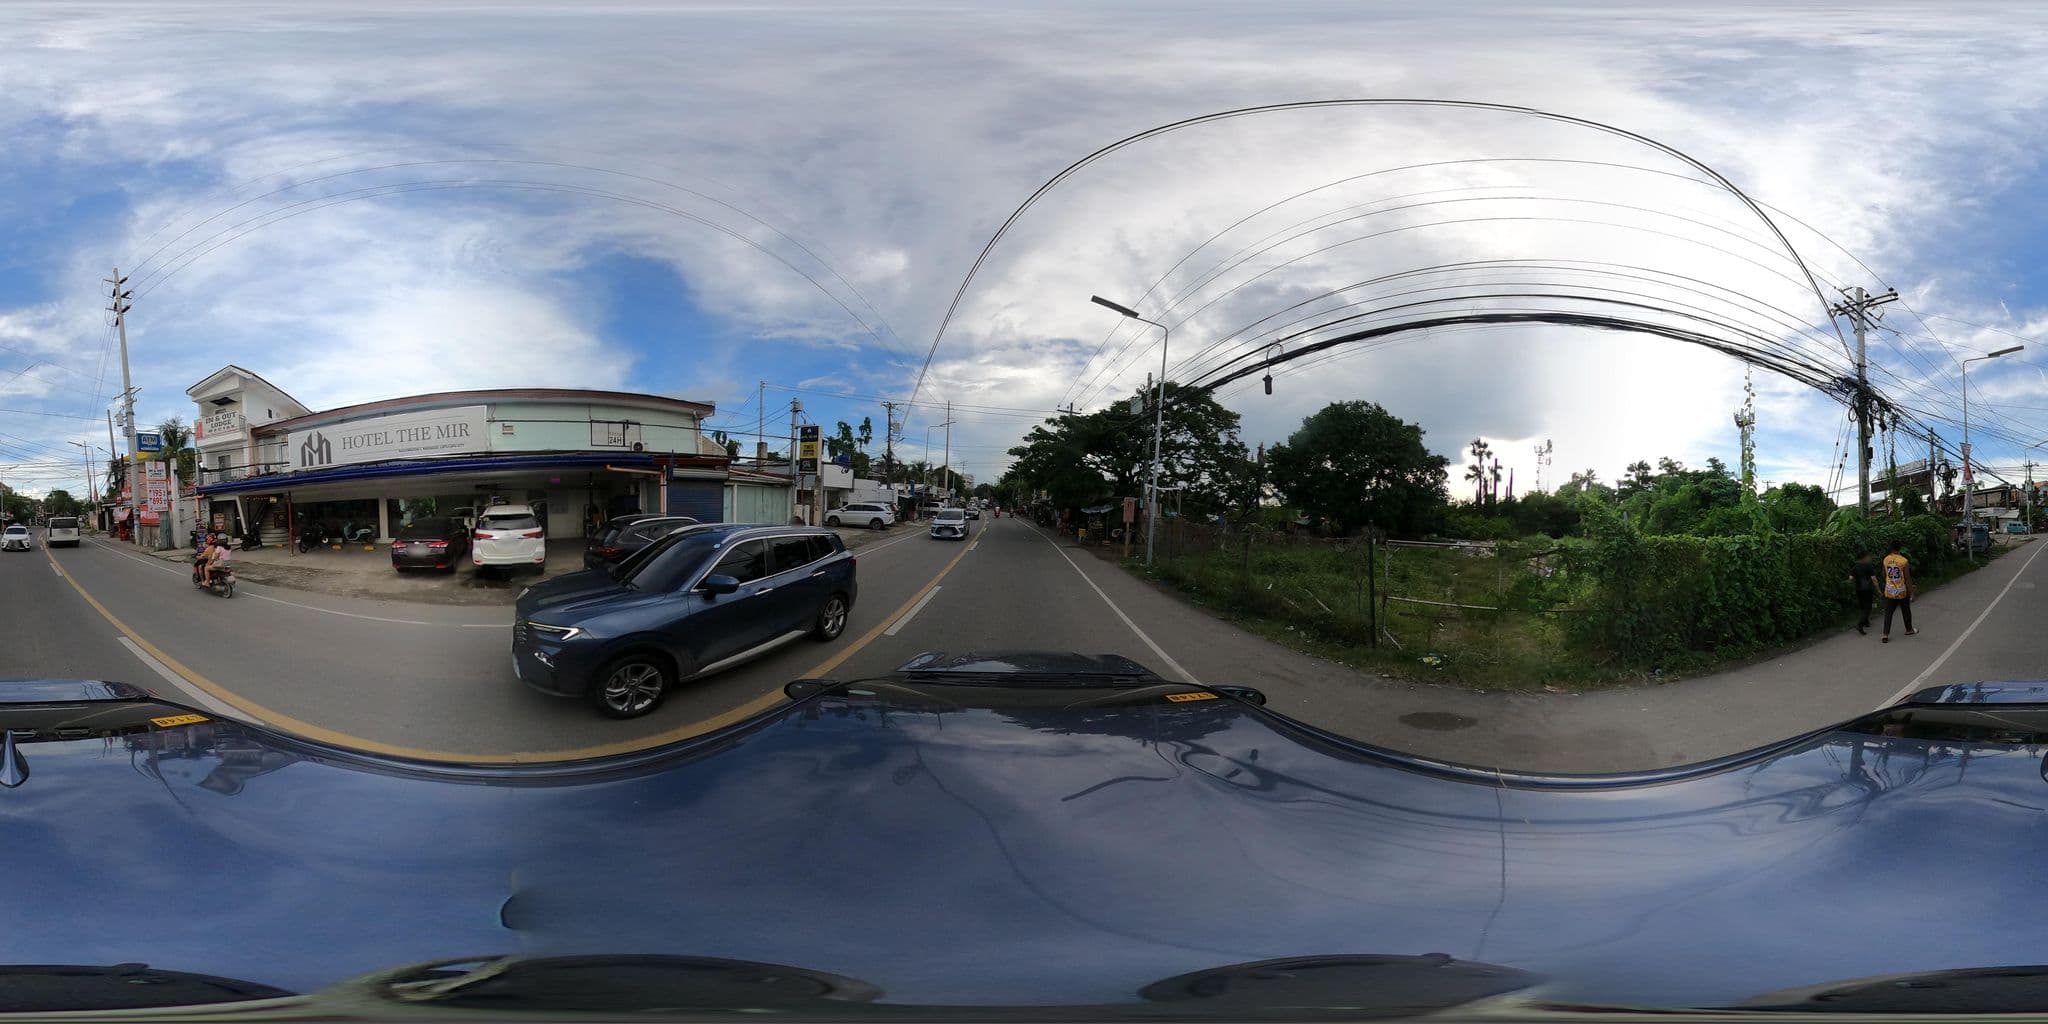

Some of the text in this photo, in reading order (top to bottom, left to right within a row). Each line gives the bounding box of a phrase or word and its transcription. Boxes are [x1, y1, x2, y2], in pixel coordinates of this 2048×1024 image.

[205, 416, 214, 425] IN
[222, 411, 237, 420] OUT
[210, 419, 232, 429] LODGE
[142, 436, 156, 444] ATM
[342, 431, 394, 450] HOTEL
[397, 425, 432, 443] THE
[437, 422, 471, 439] MIR
[609, 436, 622, 445] 24H
[1887, 566, 1901, 580] 23
